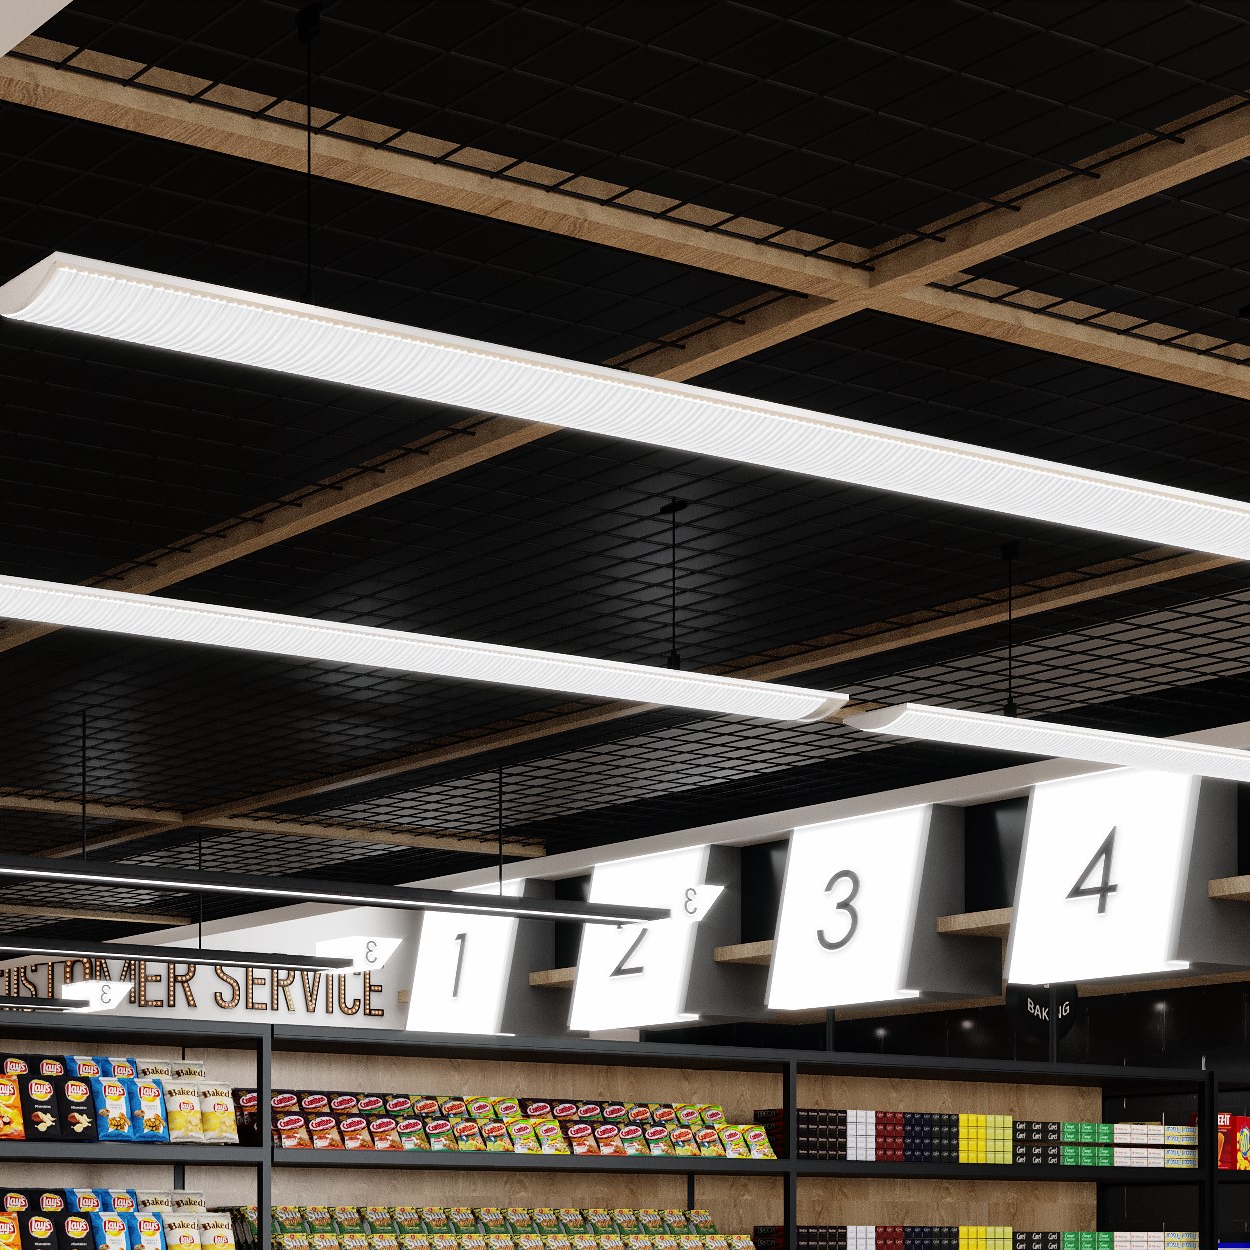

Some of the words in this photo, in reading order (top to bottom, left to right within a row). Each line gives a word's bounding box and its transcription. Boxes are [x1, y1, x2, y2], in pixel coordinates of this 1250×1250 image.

[1065, 825, 1118, 914] 4
[816, 869, 861, 951] 3
[452, 933, 467, 997] 1
[214, 963, 384, 1016] SERVICE
[1028, 998, 1070, 1021] BAKG
[80, 1064, 98, 1074] Lay's
[31, 1082, 51, 1094] Lay's
[67, 1083, 87, 1095] Lay's
[106, 1085, 125, 1097] Lay's
[141, 1087, 160, 1098] Lay's
[31, 1219, 51, 1231] Lay's
[67, 1220, 87, 1231] Lay's
[106, 1220, 125, 1231] Lay's
[141, 1220, 160, 1232] Lay's
